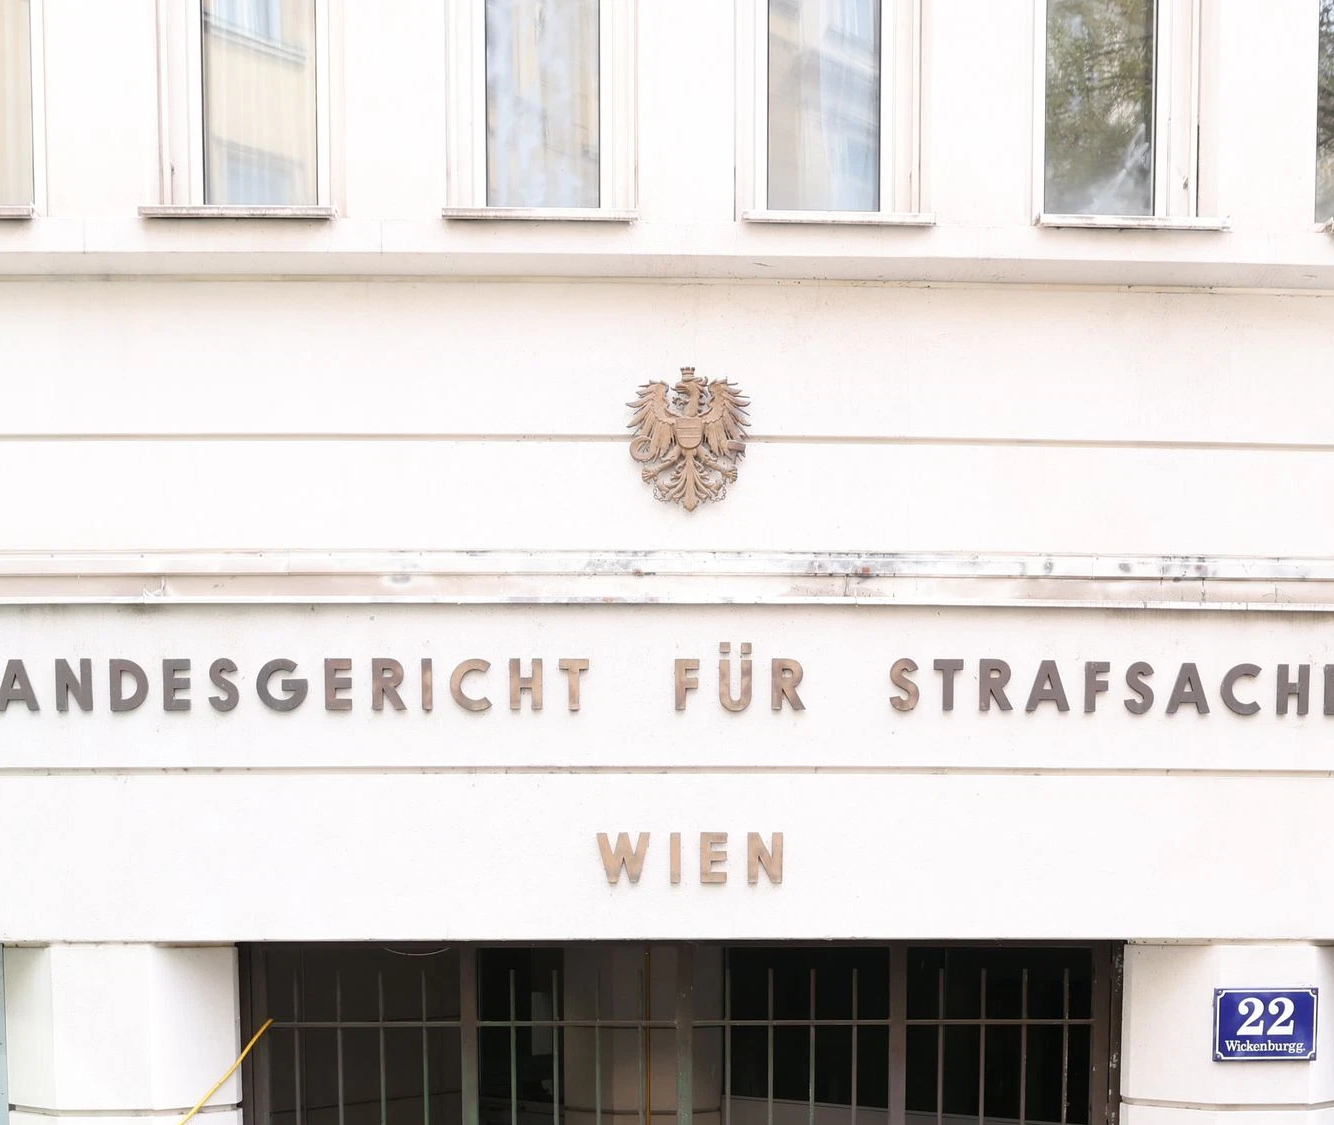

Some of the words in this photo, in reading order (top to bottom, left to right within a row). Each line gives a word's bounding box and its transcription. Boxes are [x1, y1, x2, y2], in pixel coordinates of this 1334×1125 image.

[674, 641, 805, 712] FÜR
[596, 832, 783, 884] WIEN
[1237, 997, 1295, 1036] 22
[1225, 1040, 1306, 1054] Wickenburgg.
